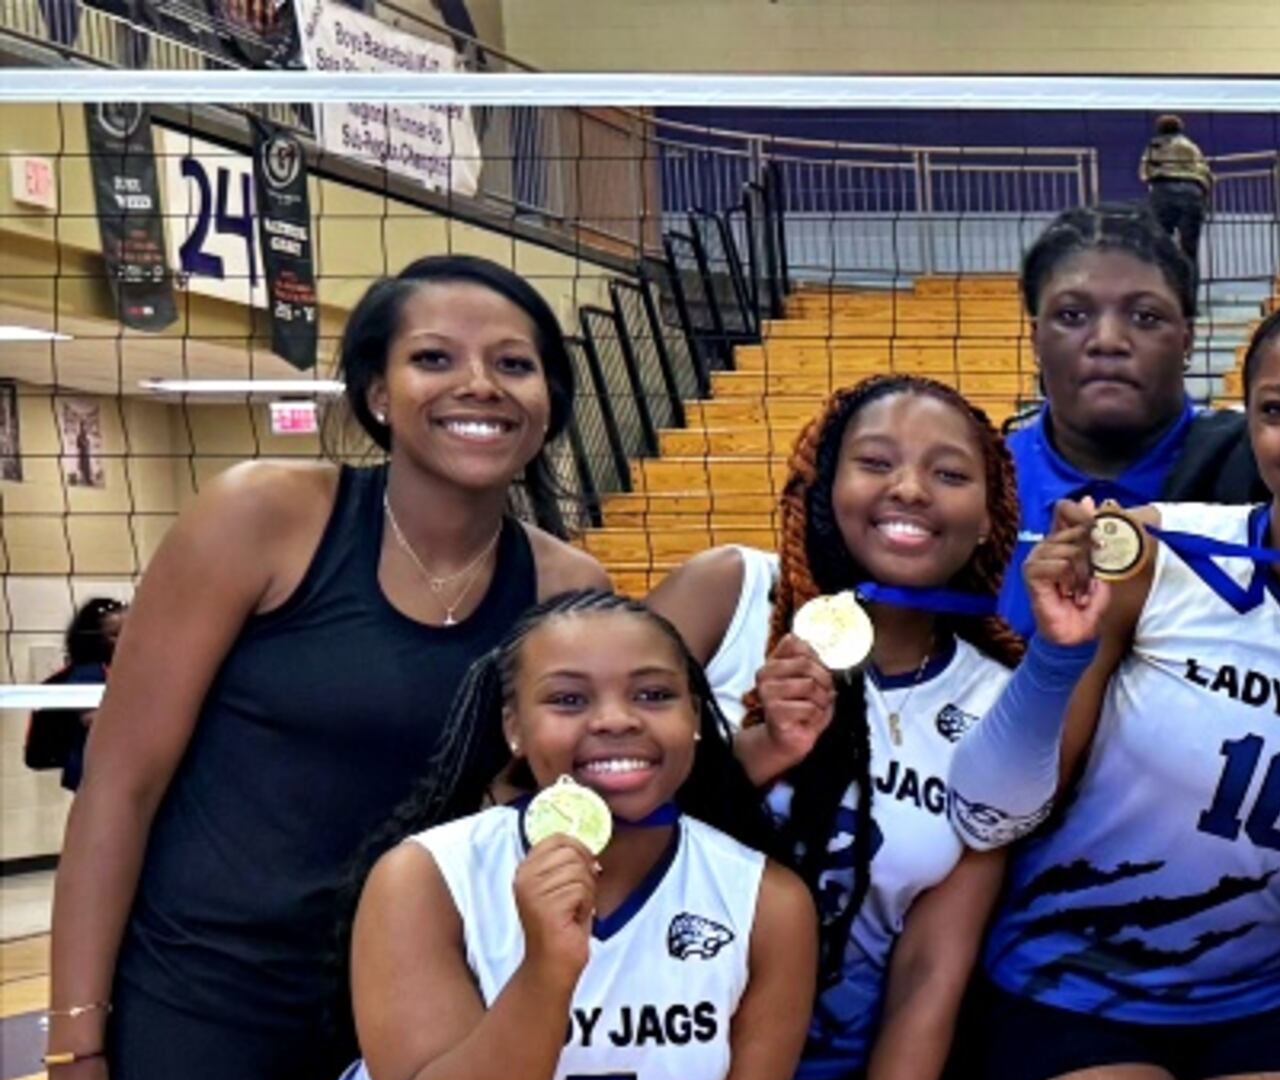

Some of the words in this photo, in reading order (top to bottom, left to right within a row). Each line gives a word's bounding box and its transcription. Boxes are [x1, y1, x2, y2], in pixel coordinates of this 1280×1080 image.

[180, 157, 259, 288] 24
[875, 760, 948, 817] JAG
[607, 1000, 718, 1048] JAGS
